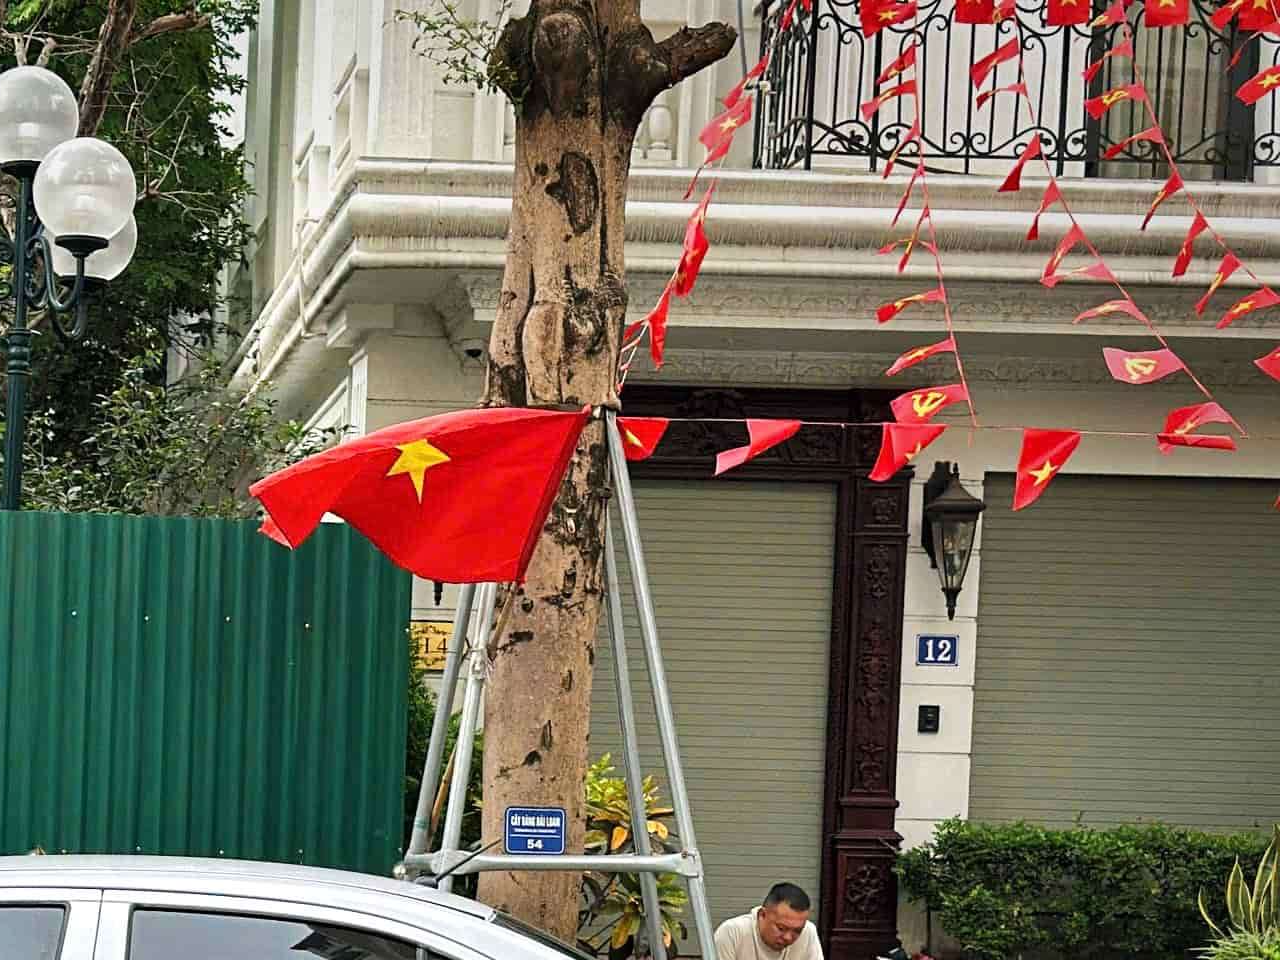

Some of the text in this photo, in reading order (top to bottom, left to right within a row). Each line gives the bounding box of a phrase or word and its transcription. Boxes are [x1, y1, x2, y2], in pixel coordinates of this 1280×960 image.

[425, 637, 448, 654] 14
[924, 639, 951, 661] 12
[528, 839, 542, 848] 54
